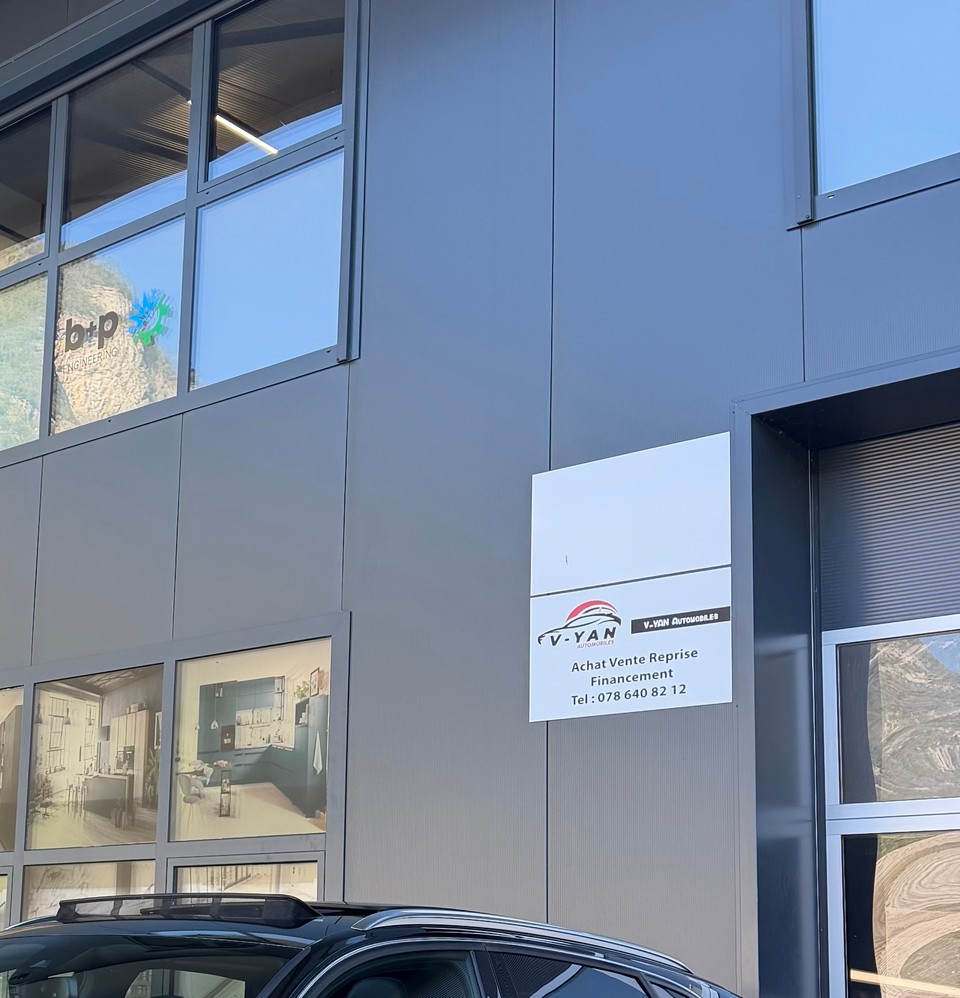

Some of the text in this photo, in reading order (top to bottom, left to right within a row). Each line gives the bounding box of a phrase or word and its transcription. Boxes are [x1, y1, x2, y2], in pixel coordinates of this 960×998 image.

[65, 311, 119, 353] b+p
[63, 346, 120, 374] ENGINEERING
[644, 617, 670, 629] V-YAN
[550, 626, 617, 647] V-YAN
[576, 640, 615, 649] AUTOMOBILES
[571, 648, 698, 673] Achat Vente Reprise
[590, 668, 674, 687] Financement
[597, 691, 621, 703] 078
[624, 687, 648, 700] 640
[651, 685, 667, 697] 82
[671, 683, 687, 695] 12
